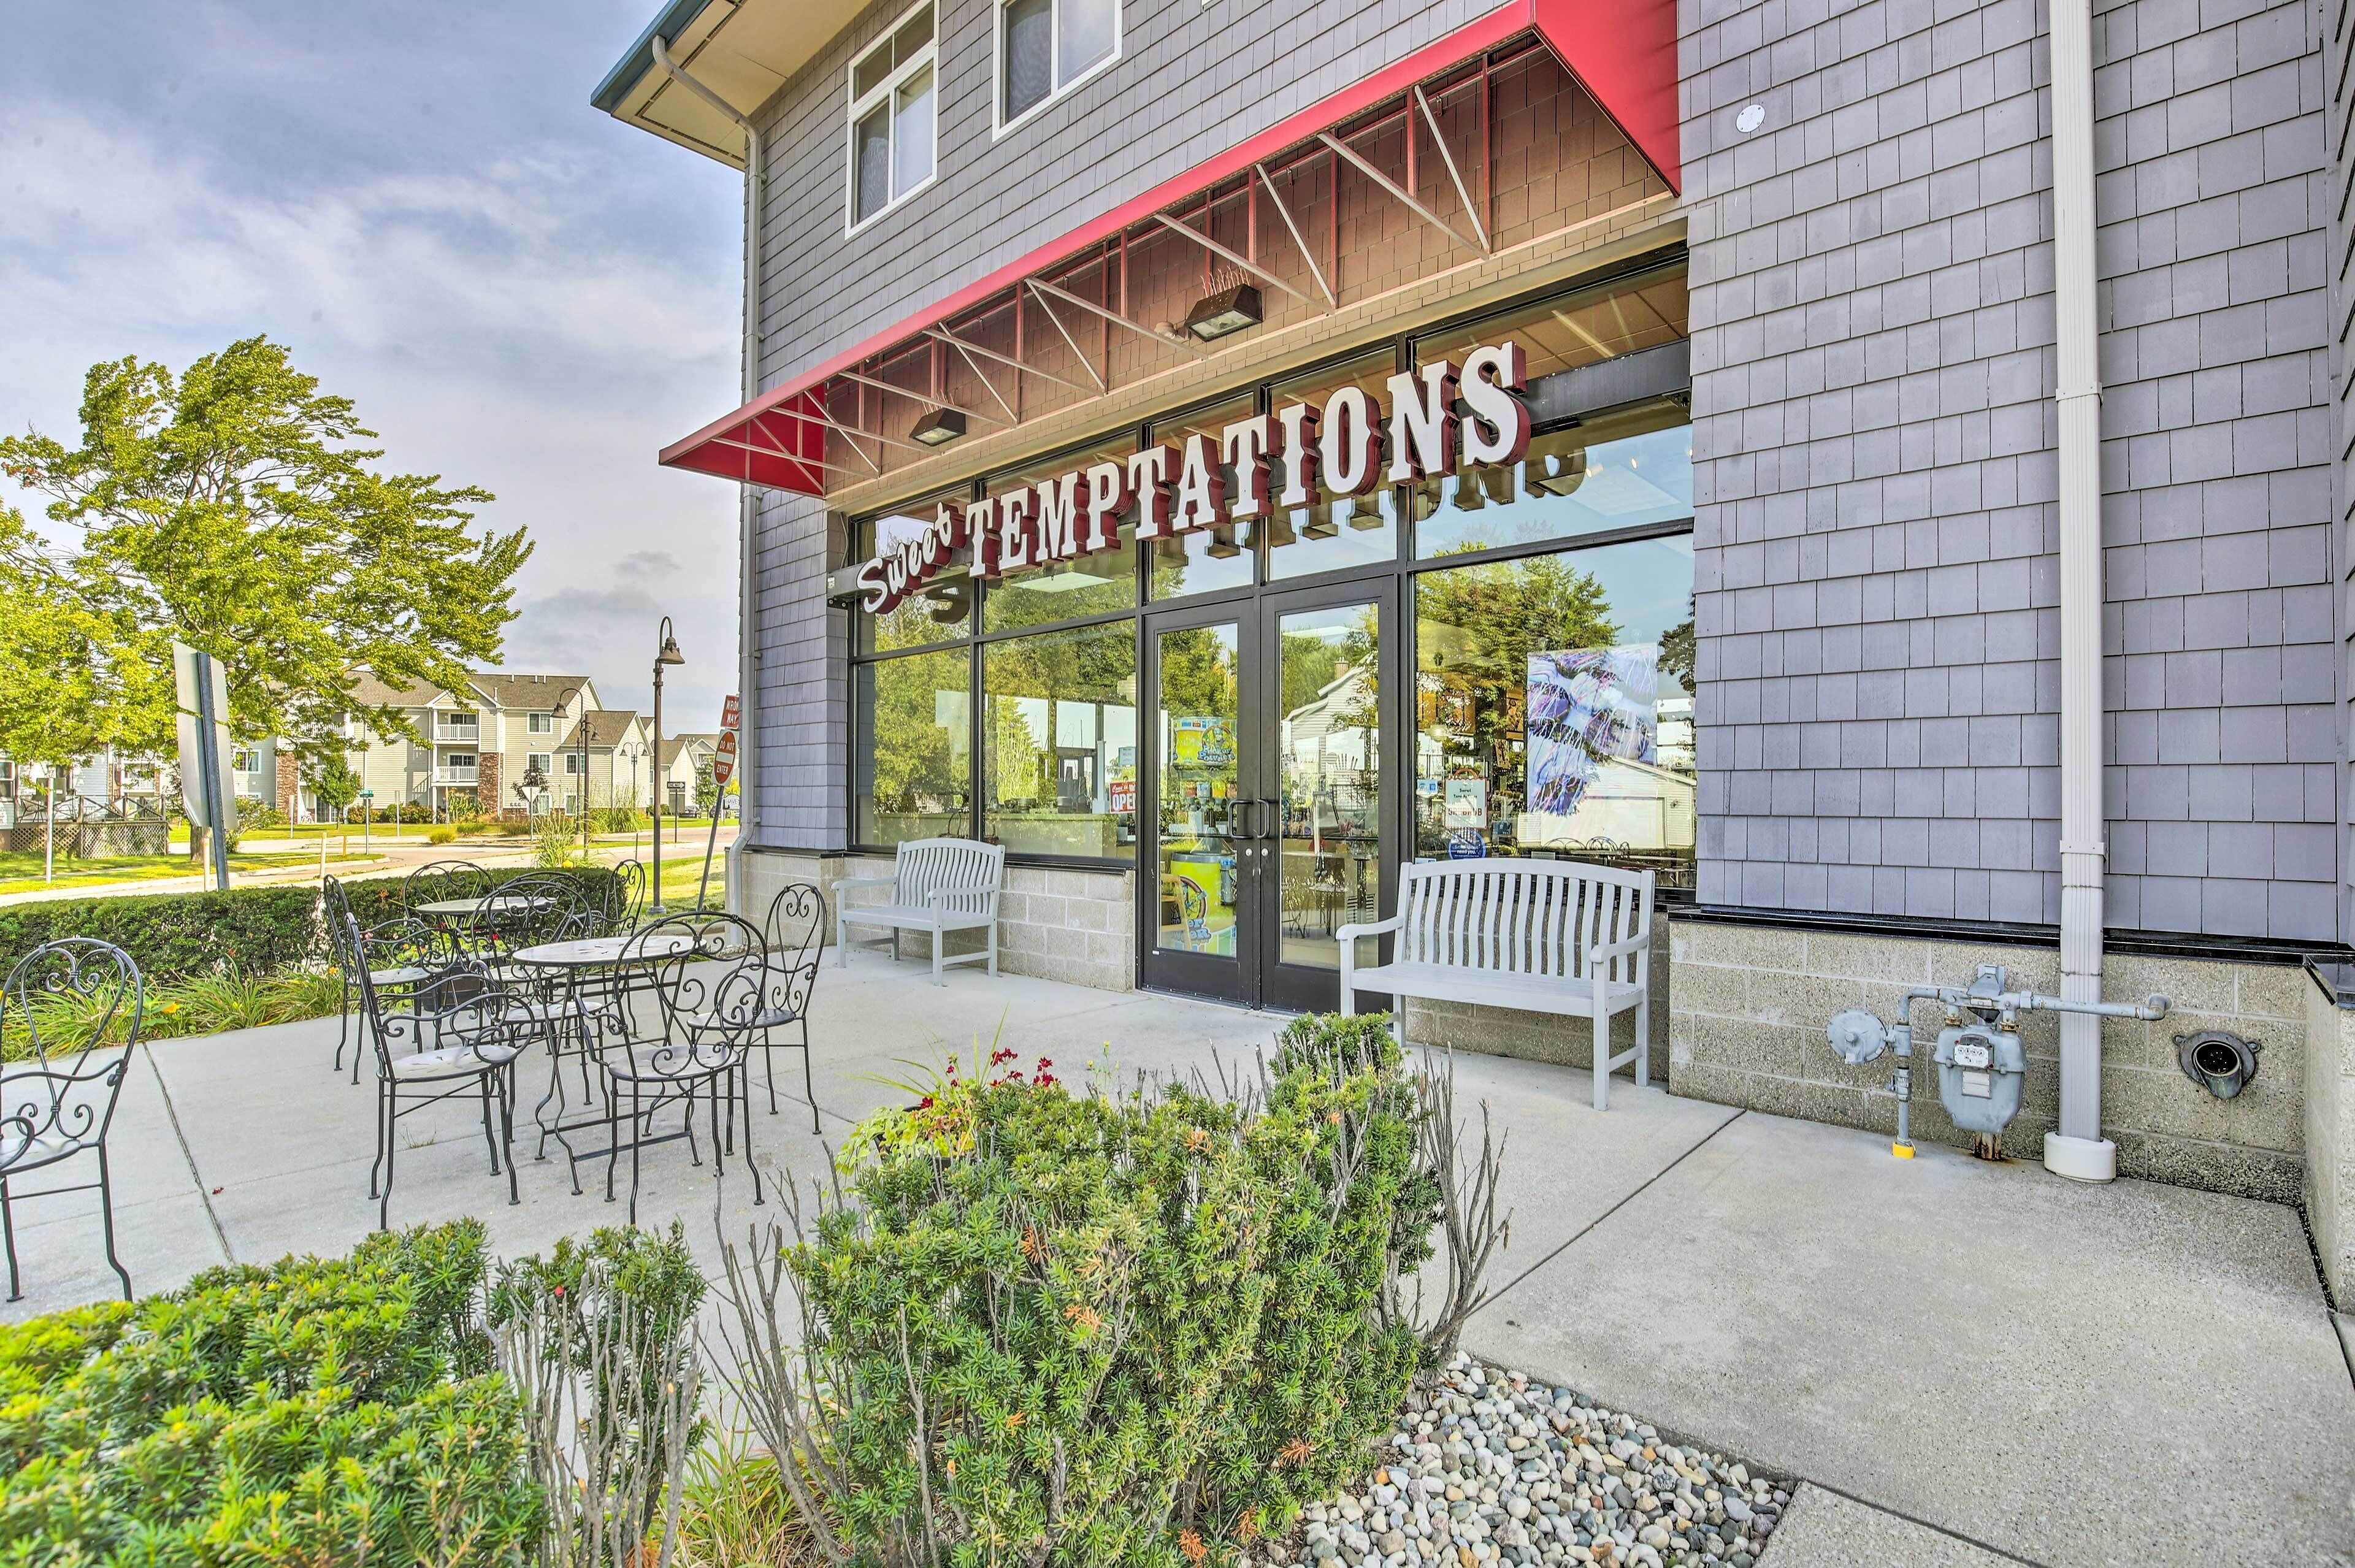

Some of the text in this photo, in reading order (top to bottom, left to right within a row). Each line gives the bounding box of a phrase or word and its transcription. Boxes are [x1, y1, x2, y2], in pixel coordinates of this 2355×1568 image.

[856, 339, 1527, 614] Sweet TEMPTATIONS
[726, 700, 739, 712] WRON
[727, 713, 738, 725] WAY
[719, 740, 726, 749] DO
[716, 764, 729, 776] ENTER
